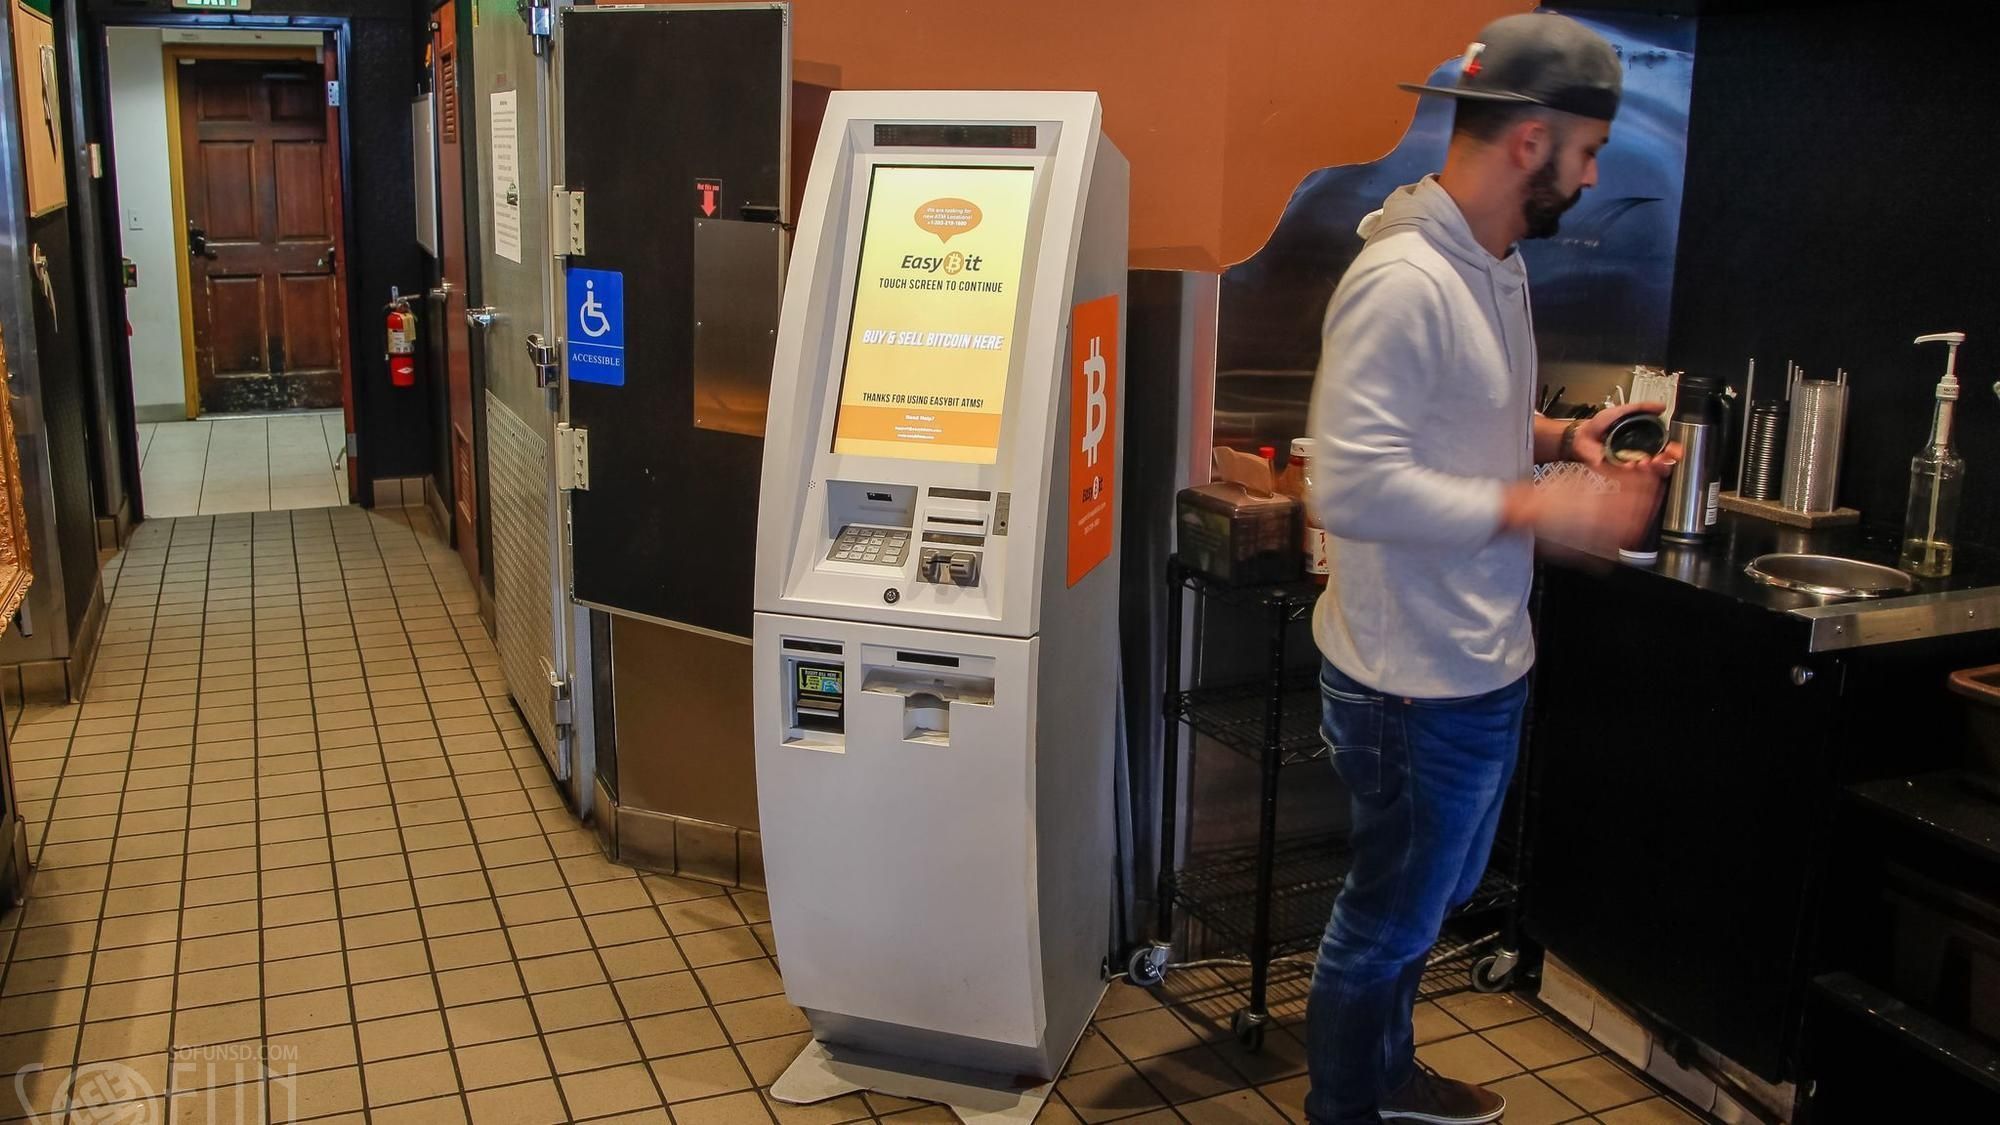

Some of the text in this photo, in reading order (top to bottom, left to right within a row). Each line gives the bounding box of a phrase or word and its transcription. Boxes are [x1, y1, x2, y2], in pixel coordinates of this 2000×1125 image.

[879, 277, 1003, 292] TOUCH SCREEN TO CONTINUE
[862, 329, 1004, 350] BUY & SELL BITCOIN HERE
[572, 353, 621, 367] ACCESSIBLE
[863, 392, 984, 408] THANKS FOR USING EASYBIT ATMS!
